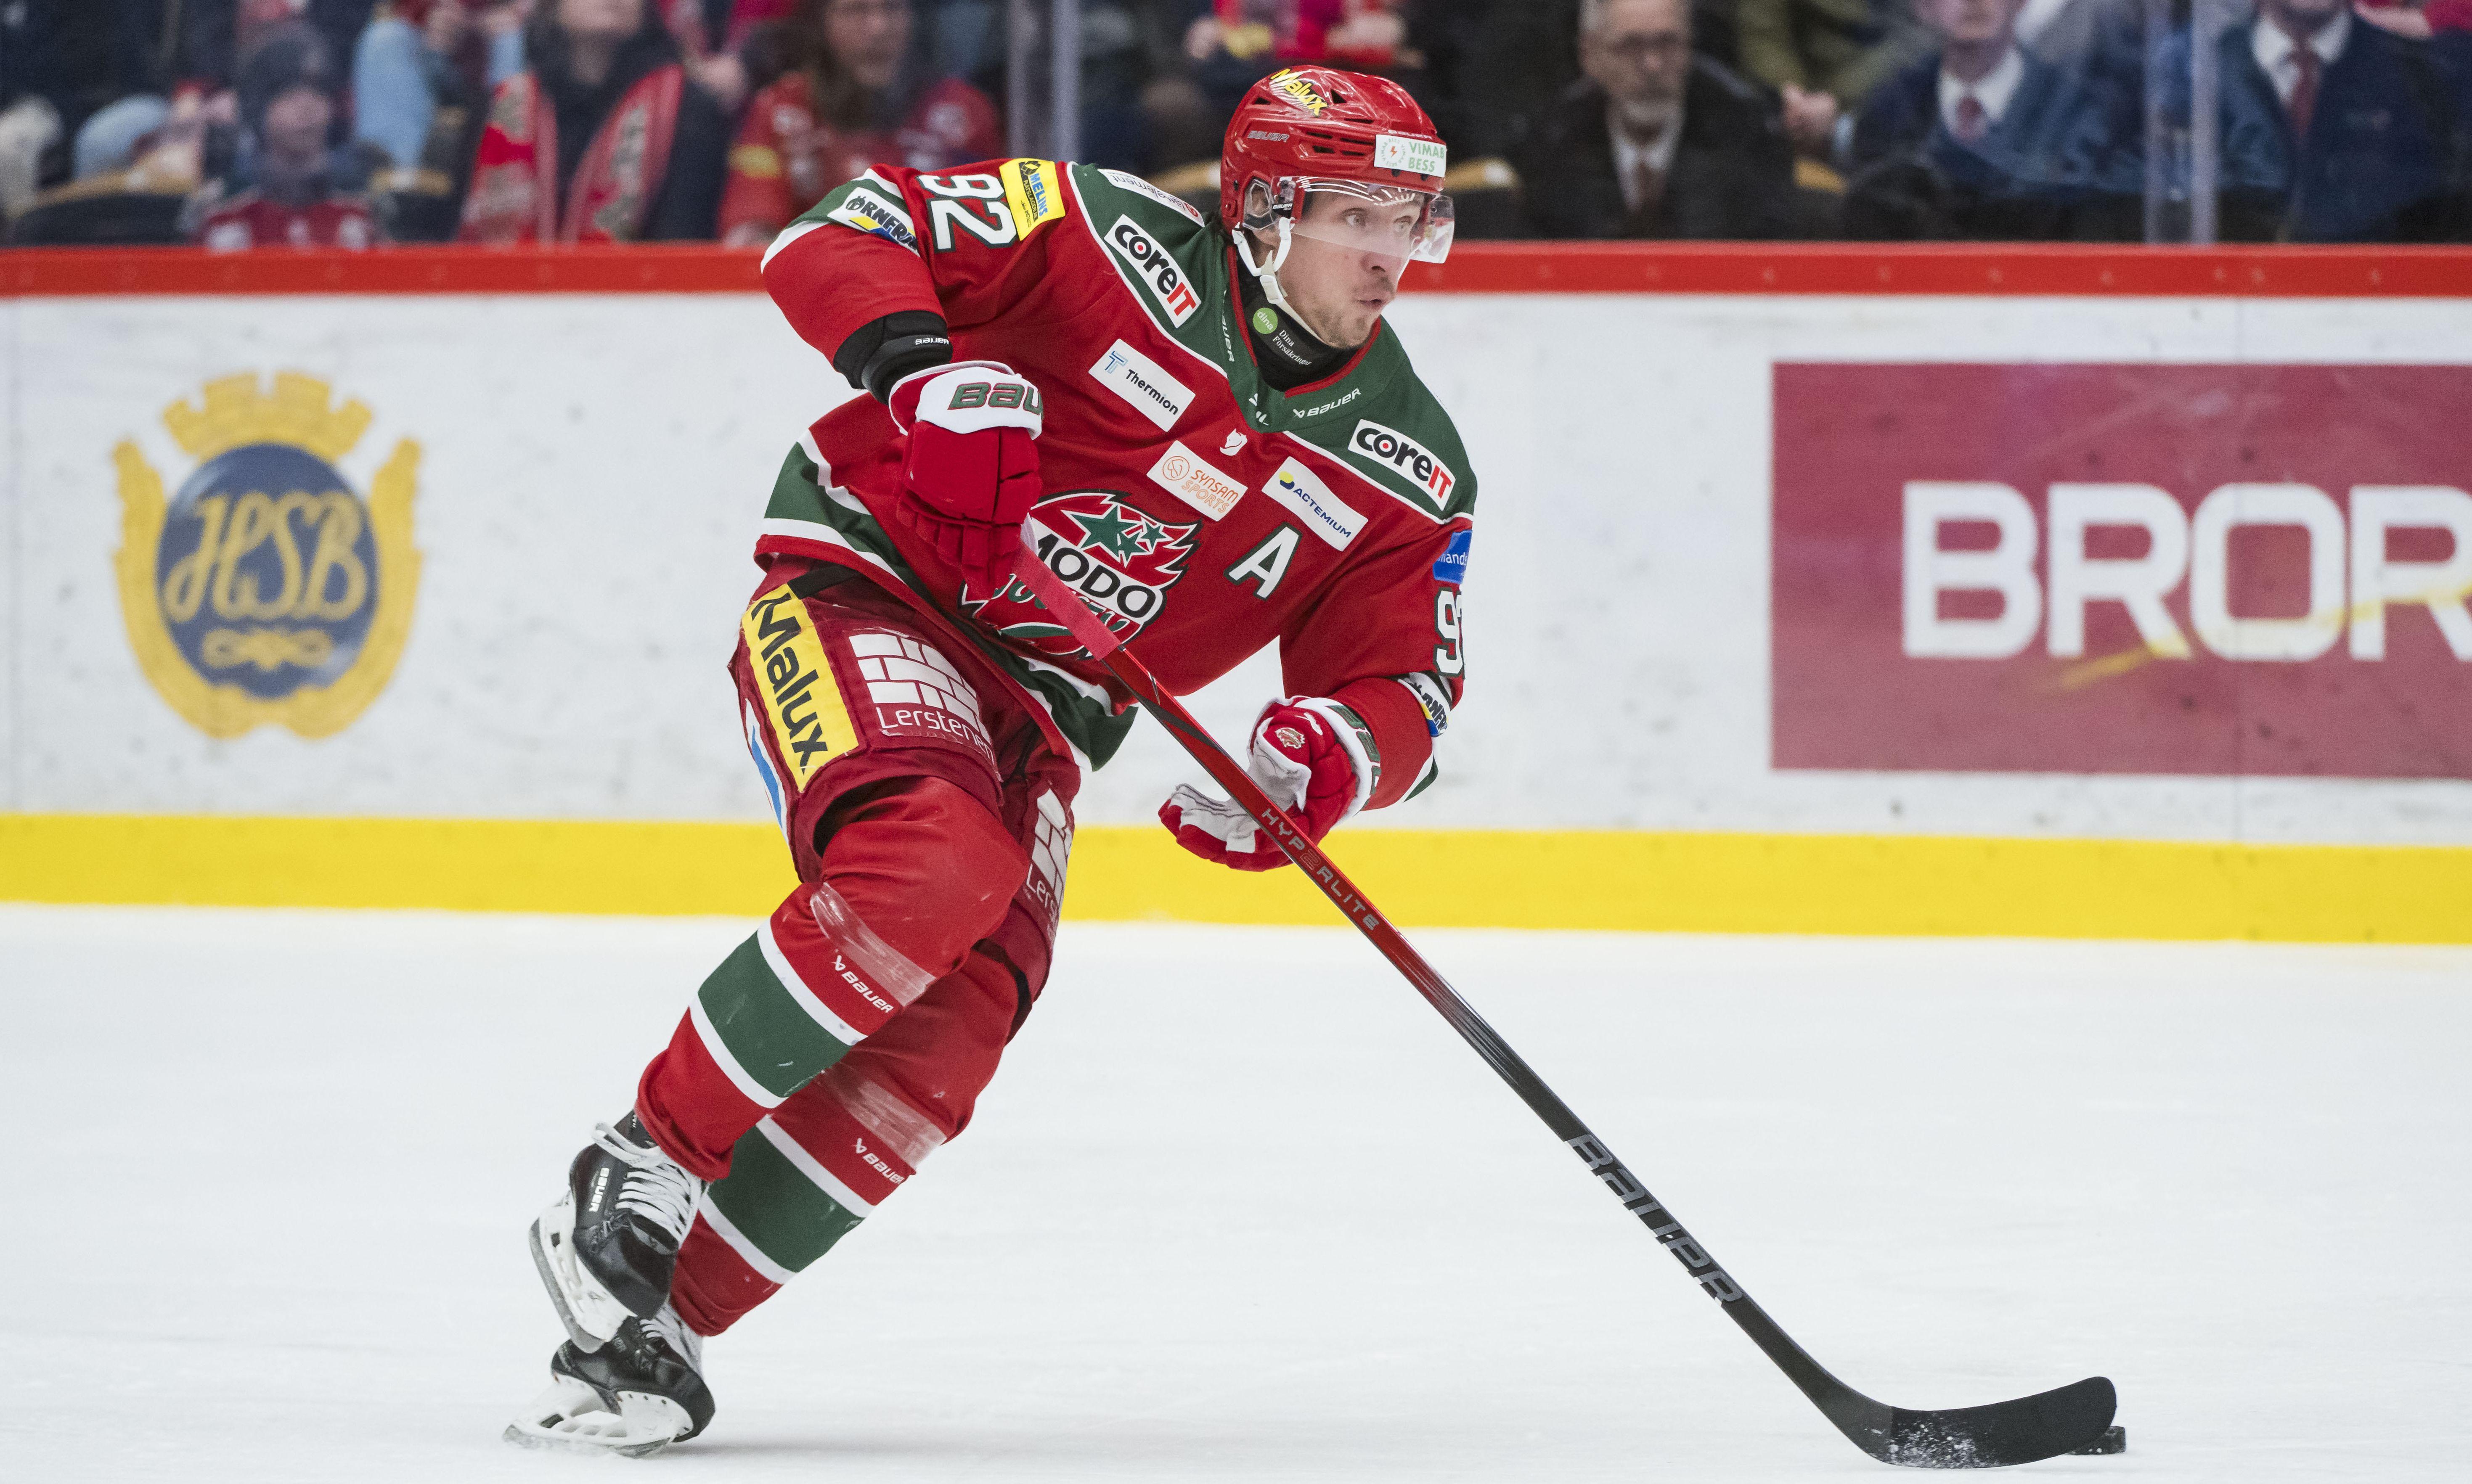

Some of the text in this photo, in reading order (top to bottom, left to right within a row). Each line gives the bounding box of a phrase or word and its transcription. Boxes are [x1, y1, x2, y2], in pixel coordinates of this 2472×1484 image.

[1269, 69, 1327, 116] Malux
[1248, 131, 1289, 142] BAUER
[1409, 142, 1444, 159] VIMAB
[1409, 157, 1435, 172] BESS
[919, 173, 1017, 252] 92
[1030, 173, 1048, 217] MELINS
[1222, 315, 1234, 362] AUER
[1257, 311, 1273, 331] dina
[1279, 330, 1294, 347] Dina
[1272, 336, 1312, 365] Försäkringar
[1125, 369, 1179, 415] Thermion
[1307, 388, 1361, 416] BAUER
[1182, 480, 1229, 513] SPORTS
[1191, 470, 1238, 503] SYNSAM
[1293, 488, 1351, 538] ACTEMIUM
[164, 490, 368, 623] HSB
[1225, 523, 1301, 601] A
[1903, 481, 2472, 661] BROR
[751, 592, 828, 775] Malux
[876, 707, 994, 764] Lerstenen
[842, 971, 894, 1013] BAUER
[863, 1153, 904, 1185] BAUER
